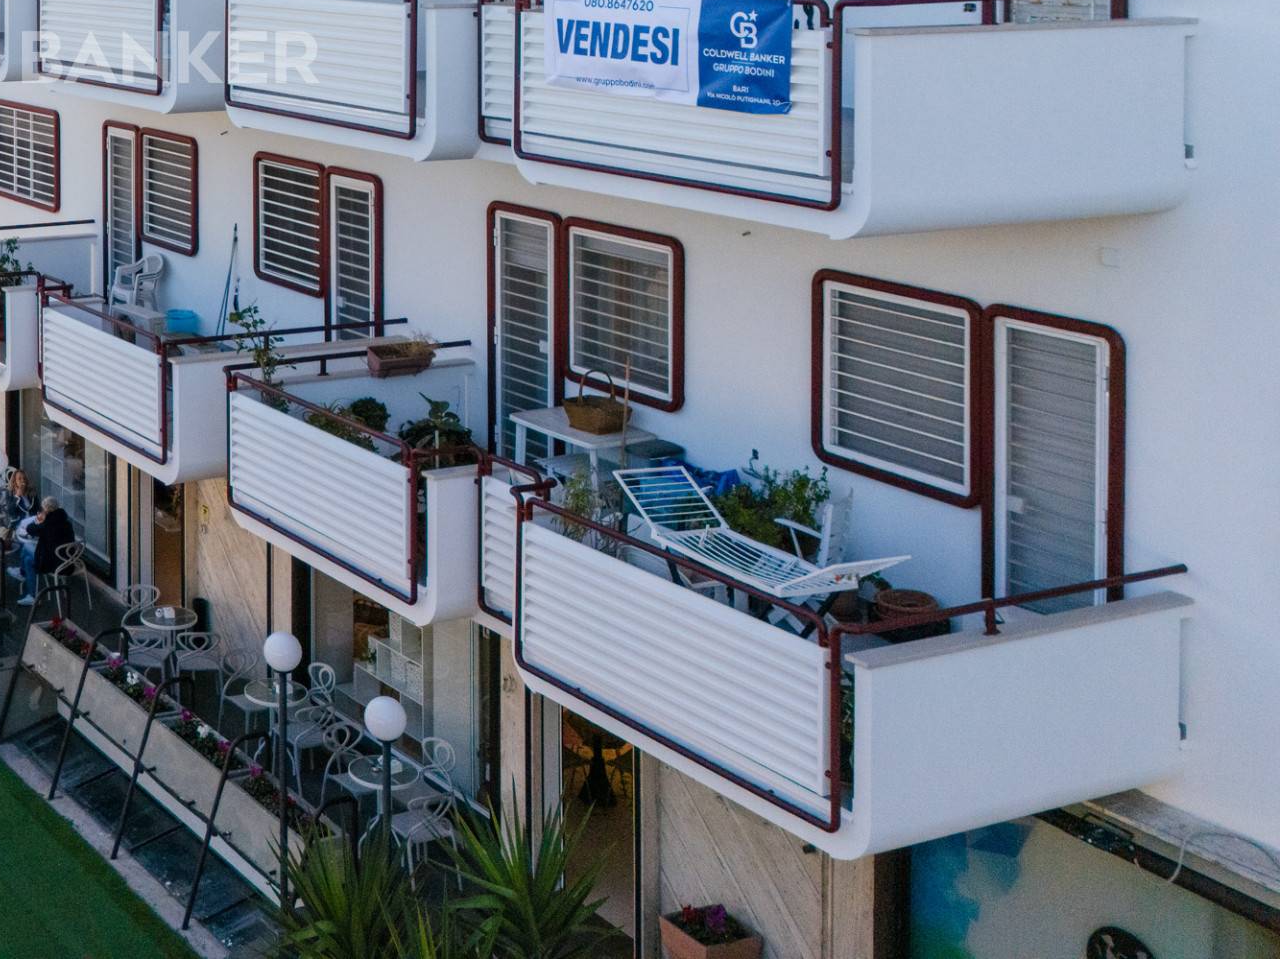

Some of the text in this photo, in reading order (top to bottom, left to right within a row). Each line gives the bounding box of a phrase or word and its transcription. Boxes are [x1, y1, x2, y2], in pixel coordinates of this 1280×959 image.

[556, 18, 680, 66] VENDESI
[702, 48, 786, 65] COLDWELL BANKER
[712, 63, 775, 78] GRUPPO BODINI
[732, 84, 749, 93] BARI
